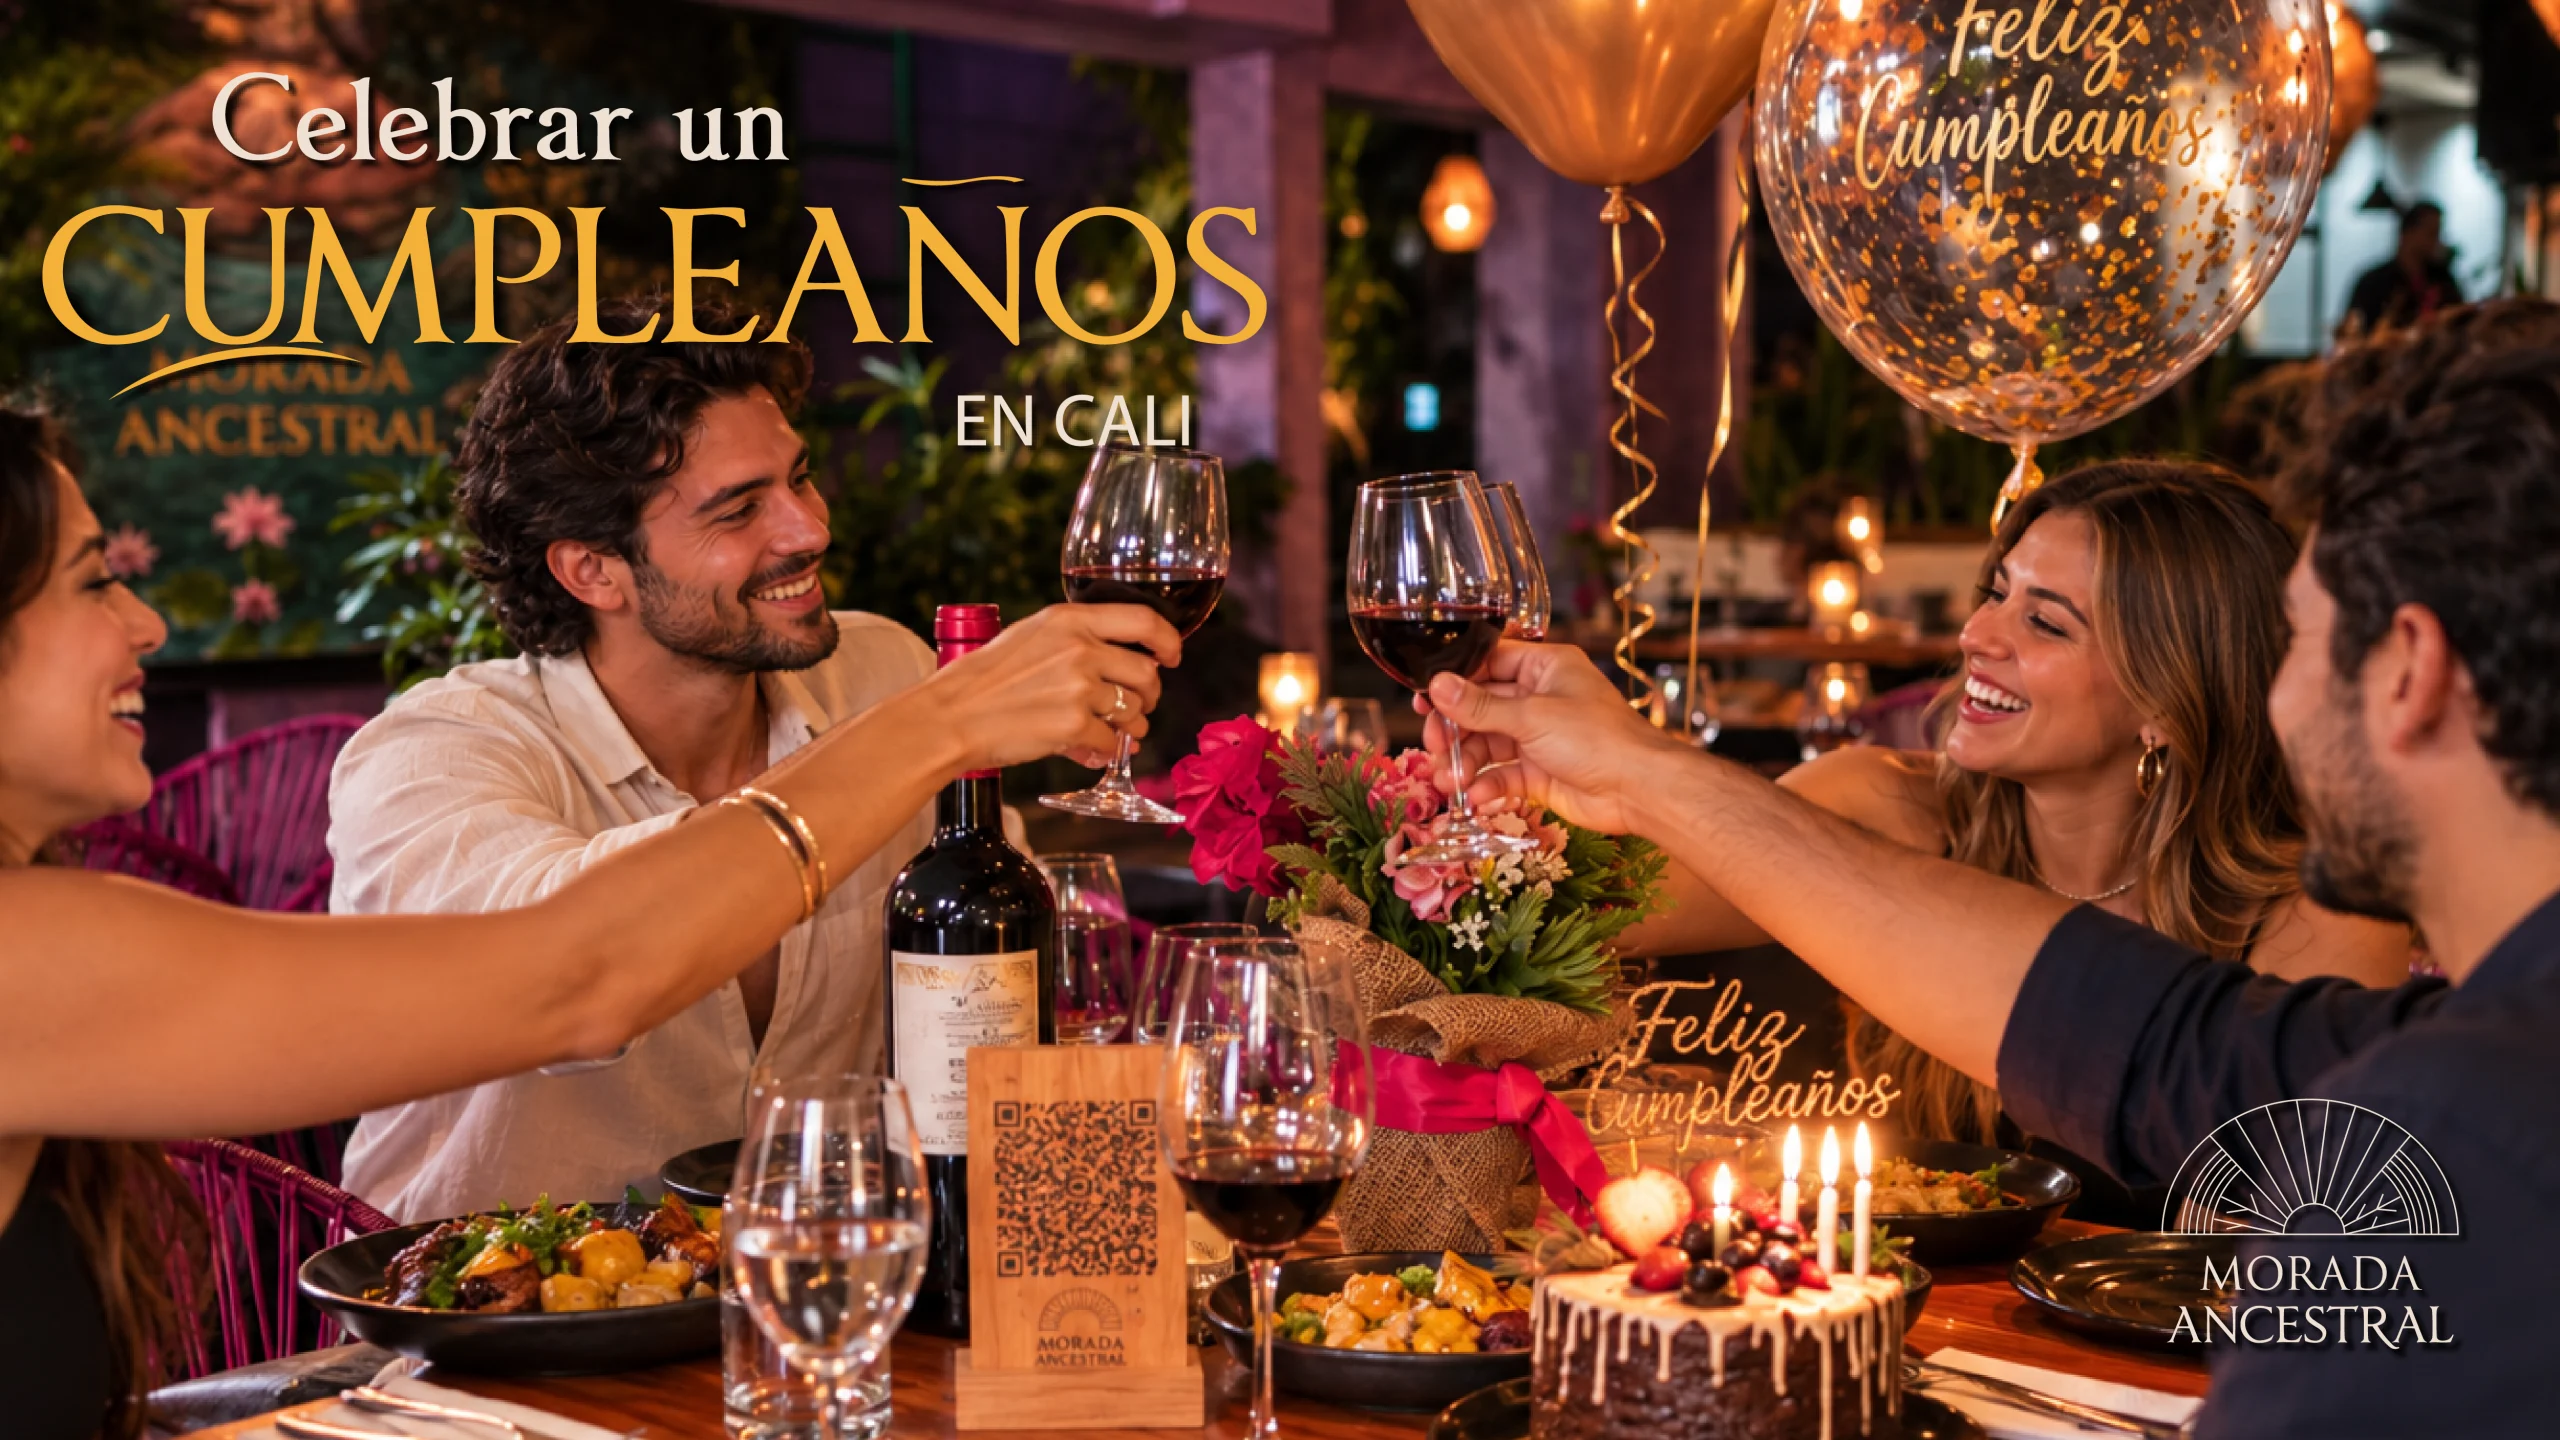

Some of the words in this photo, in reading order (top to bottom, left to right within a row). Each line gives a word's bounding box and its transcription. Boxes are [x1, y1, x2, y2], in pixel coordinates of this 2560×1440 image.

[1948, 0, 2144, 97] Feliz
[1855, 73, 2212, 208] Cumpleaños
[113, 403, 448, 457] ANCESTRAL
[1628, 975, 1806, 1082] Feliz
[1586, 1052, 1901, 1152] Cumpleaños
[1037, 1335, 1124, 1351] MORADA
